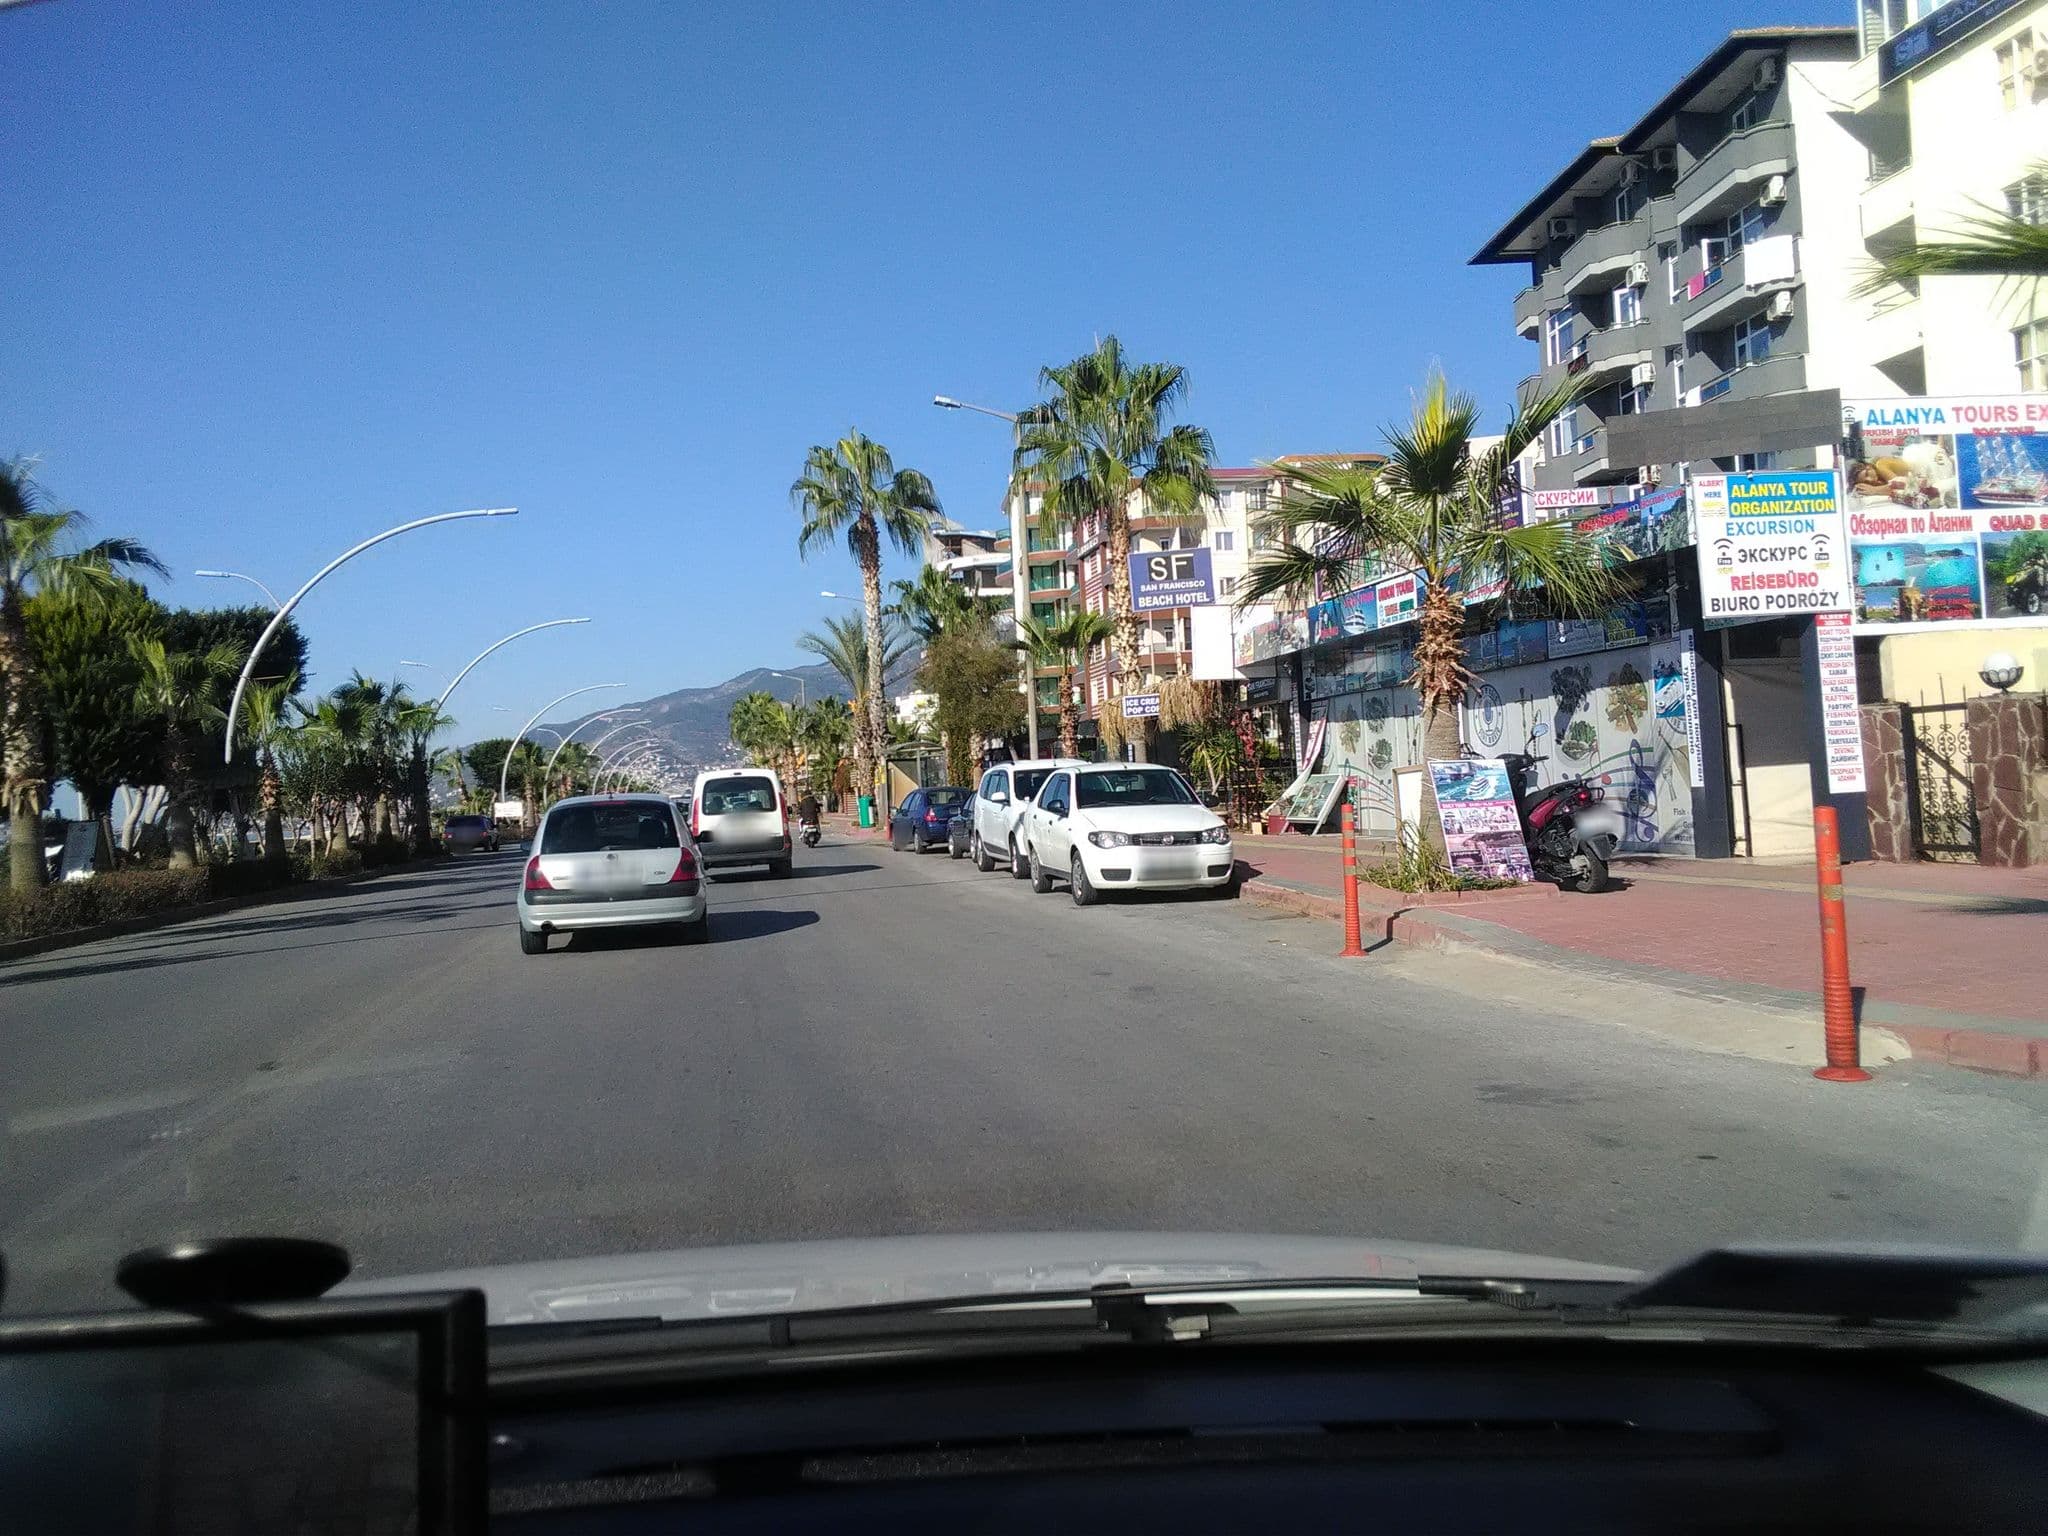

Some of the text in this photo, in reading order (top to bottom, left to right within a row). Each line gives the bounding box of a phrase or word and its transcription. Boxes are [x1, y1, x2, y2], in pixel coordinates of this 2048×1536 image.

[1866, 407, 1946, 426] ALANYA
[1952, 405, 2018, 423] TOURS
[1896, 427, 1920, 436] BATH
[1731, 482, 1828, 497] ALANYA TOUR
[1730, 499, 1834, 515] ORGANIZATION
[1726, 519, 1815, 536] EXCURSION
[1850, 511, 1973, 539] Обзорная по Алании
[1990, 514, 2035, 532] QUAD
[1738, 546, 1807, 563] ЭКСКУРС
[1150, 553, 1194, 581] SF
[1140, 581, 1205, 592] SAN FRANCISCO
[1730, 570, 1819, 591] REİSEBÜRO
[1139, 591, 1210, 608] BEACH HOTEL
[1711, 589, 1839, 612] BIURO PODRÓŻY
[1127, 706, 1143, 714] POP
